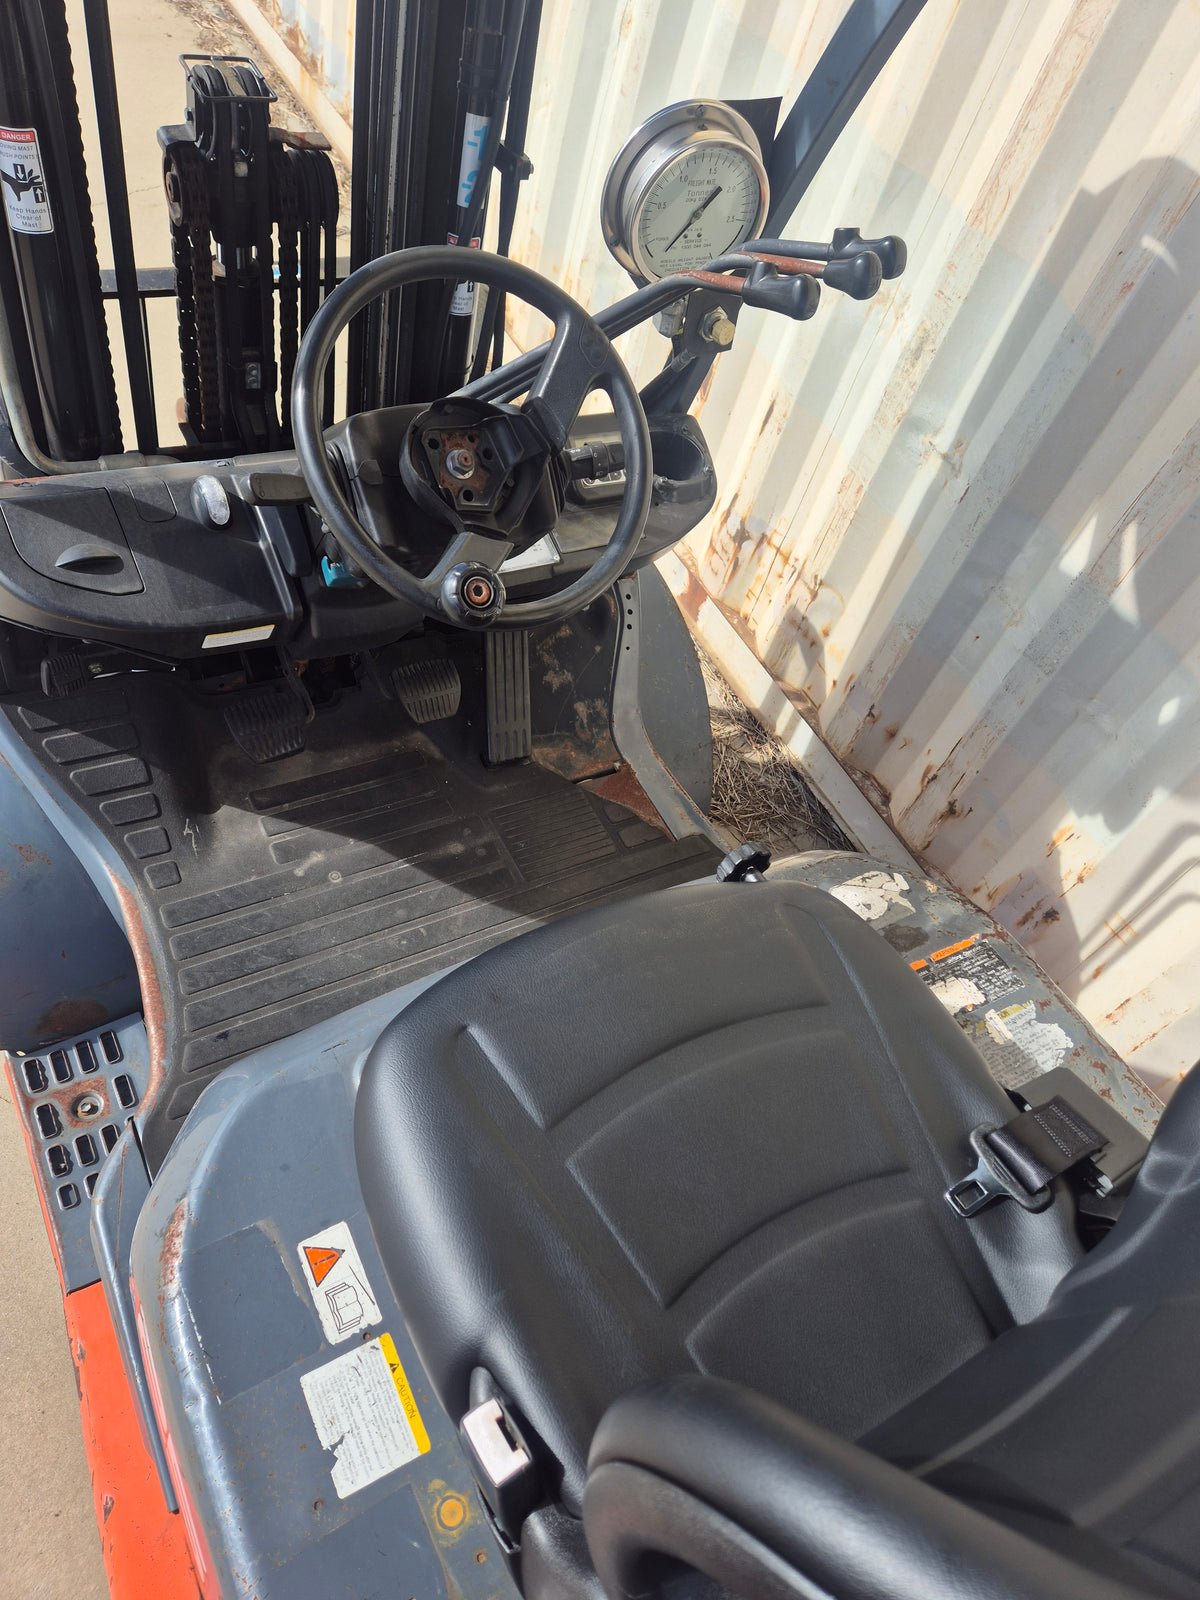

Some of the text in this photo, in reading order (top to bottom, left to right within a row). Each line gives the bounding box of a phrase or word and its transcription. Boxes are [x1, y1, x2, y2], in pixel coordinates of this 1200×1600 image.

[1, 131, 32, 141] DANGER
[0, 142, 17, 151] OVING
[709, 167, 718, 175] 1.5
[679, 175, 689, 183] 1.0
[726, 185, 736, 193] 2.0
[9, 204, 24, 213] Keep
[657, 202, 667, 210] 0.5
[15, 213, 33, 221] Clear
[396, 1377, 416, 1420] CAUTION
